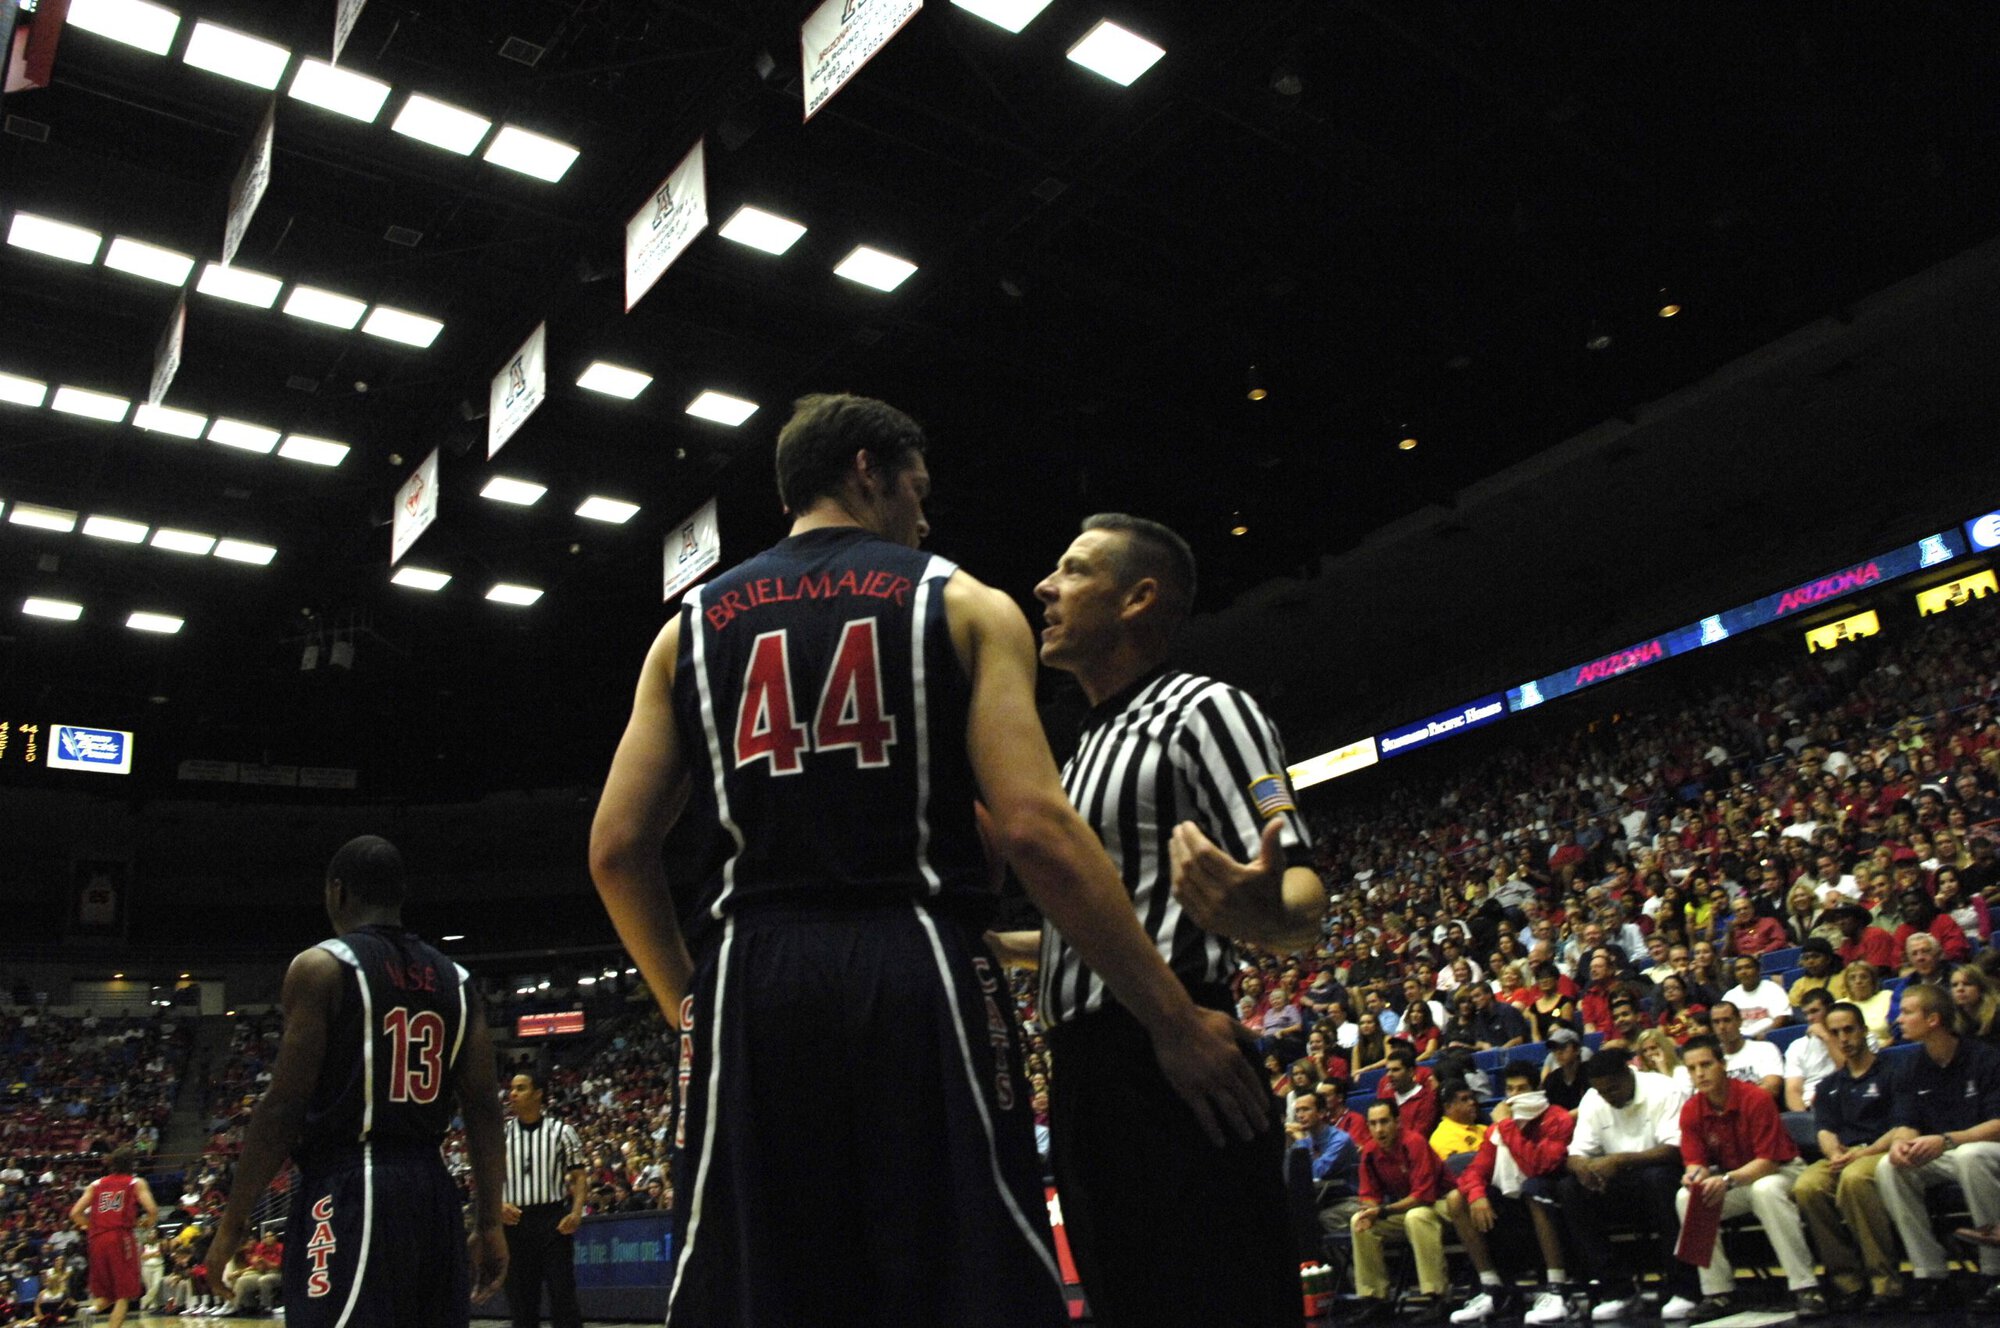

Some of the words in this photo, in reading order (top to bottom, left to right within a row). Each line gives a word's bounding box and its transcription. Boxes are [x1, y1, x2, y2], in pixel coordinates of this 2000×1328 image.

[810, 86, 829, 111] 2000
[837, 60, 855, 84] 2001
[863, 32, 884, 57] 2002
[892, 2, 913, 28] 2005
[832, 30, 860, 61] ROUND
[1919, 533, 1953, 568] A
[705, 568, 912, 632] BRIELMAIER
[1775, 562, 1880, 615] ARIZONA
[1700, 614, 1729, 646] A
[1576, 640, 1663, 686] ARIZONA
[735, 616, 898, 777] 44
[1520, 680, 1544, 709] A
[383, 1006, 445, 1104] 13
[98, 1189, 125, 1214] 54
[307, 1194, 337, 1298] CATS
